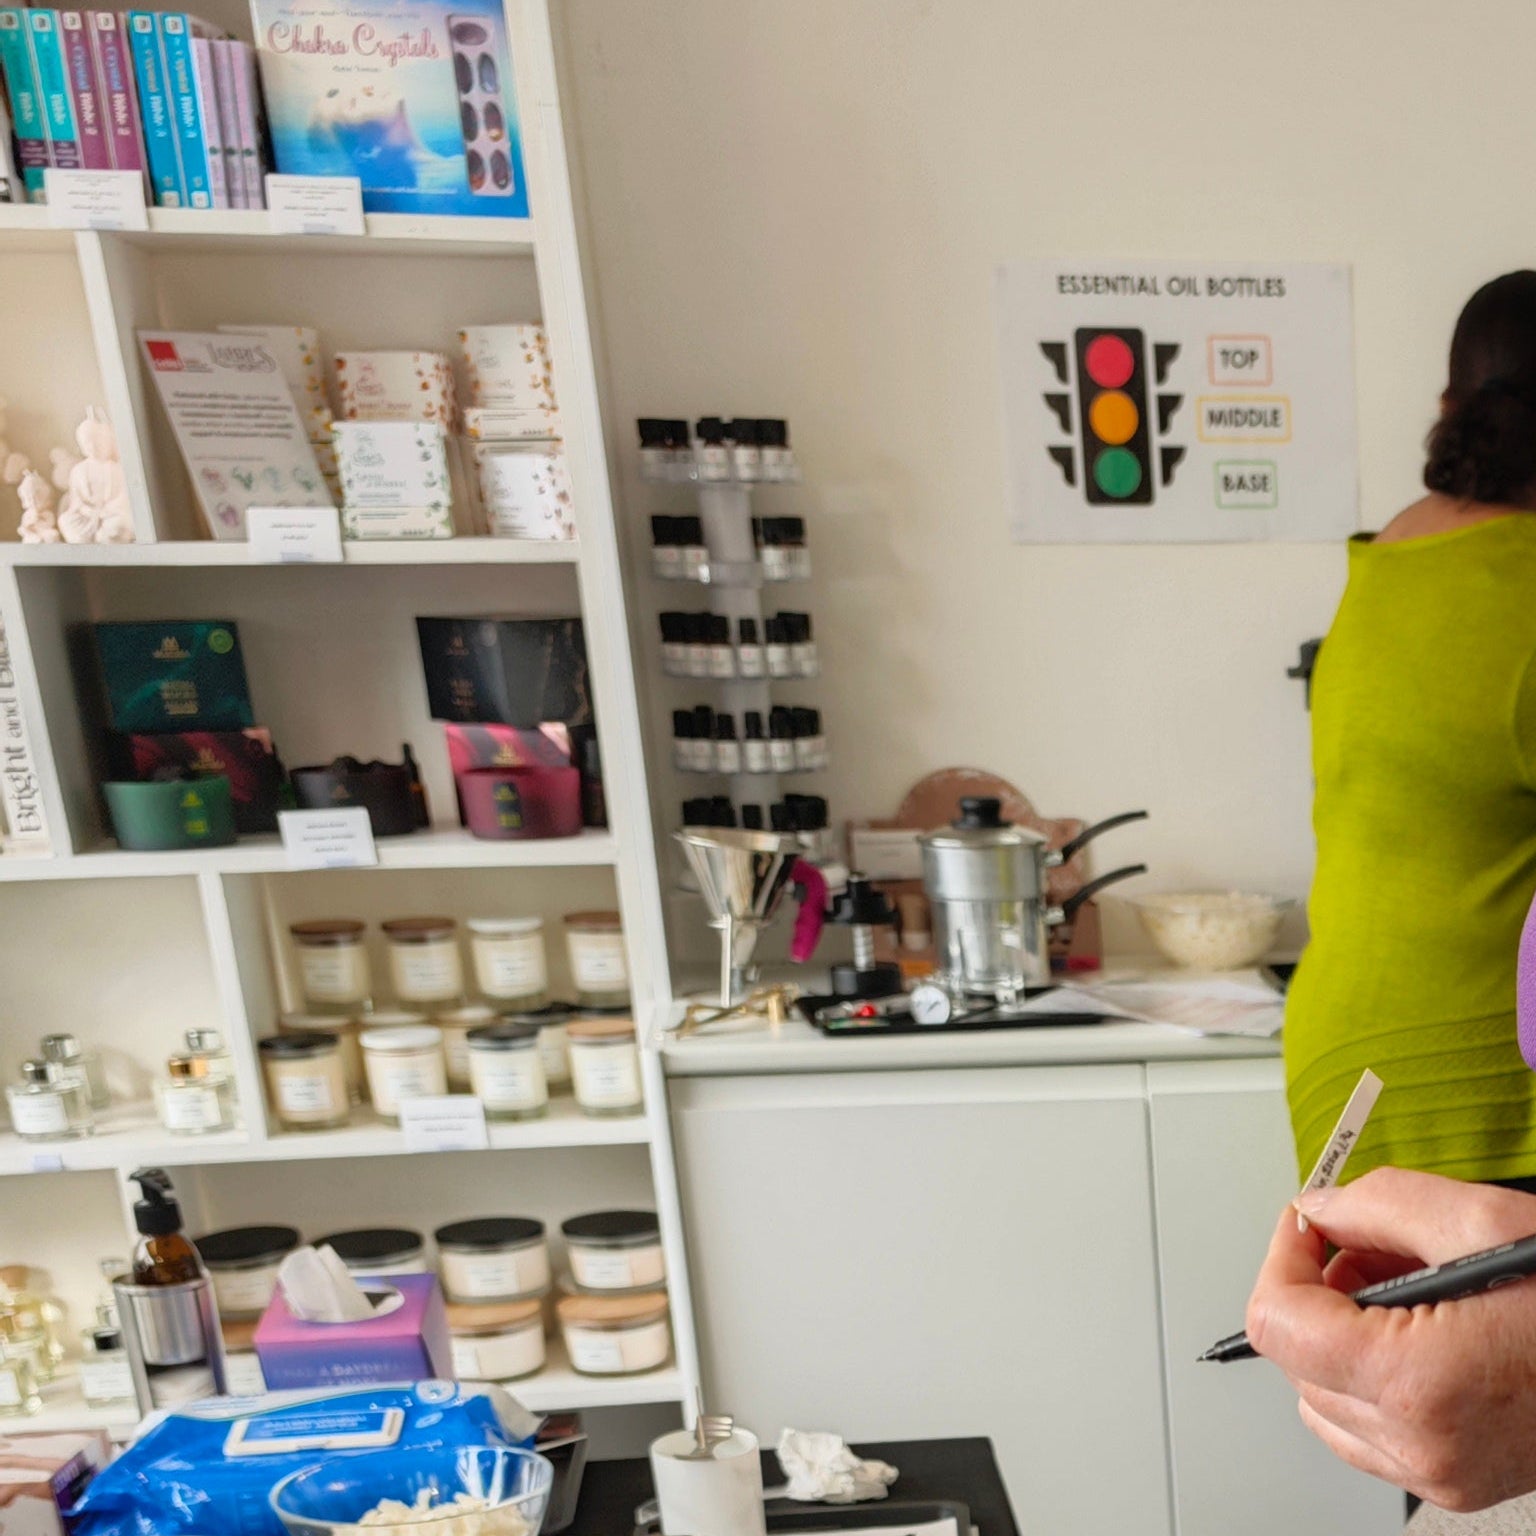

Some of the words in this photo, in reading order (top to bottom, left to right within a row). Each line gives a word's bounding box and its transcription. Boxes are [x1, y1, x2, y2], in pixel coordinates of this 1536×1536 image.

[267, 20, 349, 54] Chakra
[352, 22, 440, 67] Crystals
[1057, 274, 1160, 296] ESSENTIAL
[1165, 275, 1200, 297] OIL
[1206, 276, 1287, 298] BOTTLES
[1219, 348, 1260, 370] TOP
[1206, 407, 1283, 429] MIDDLE
[1222, 473, 1273, 494] BASE
[2, 698, 23, 739] and
[4, 746, 42, 833] Bright
